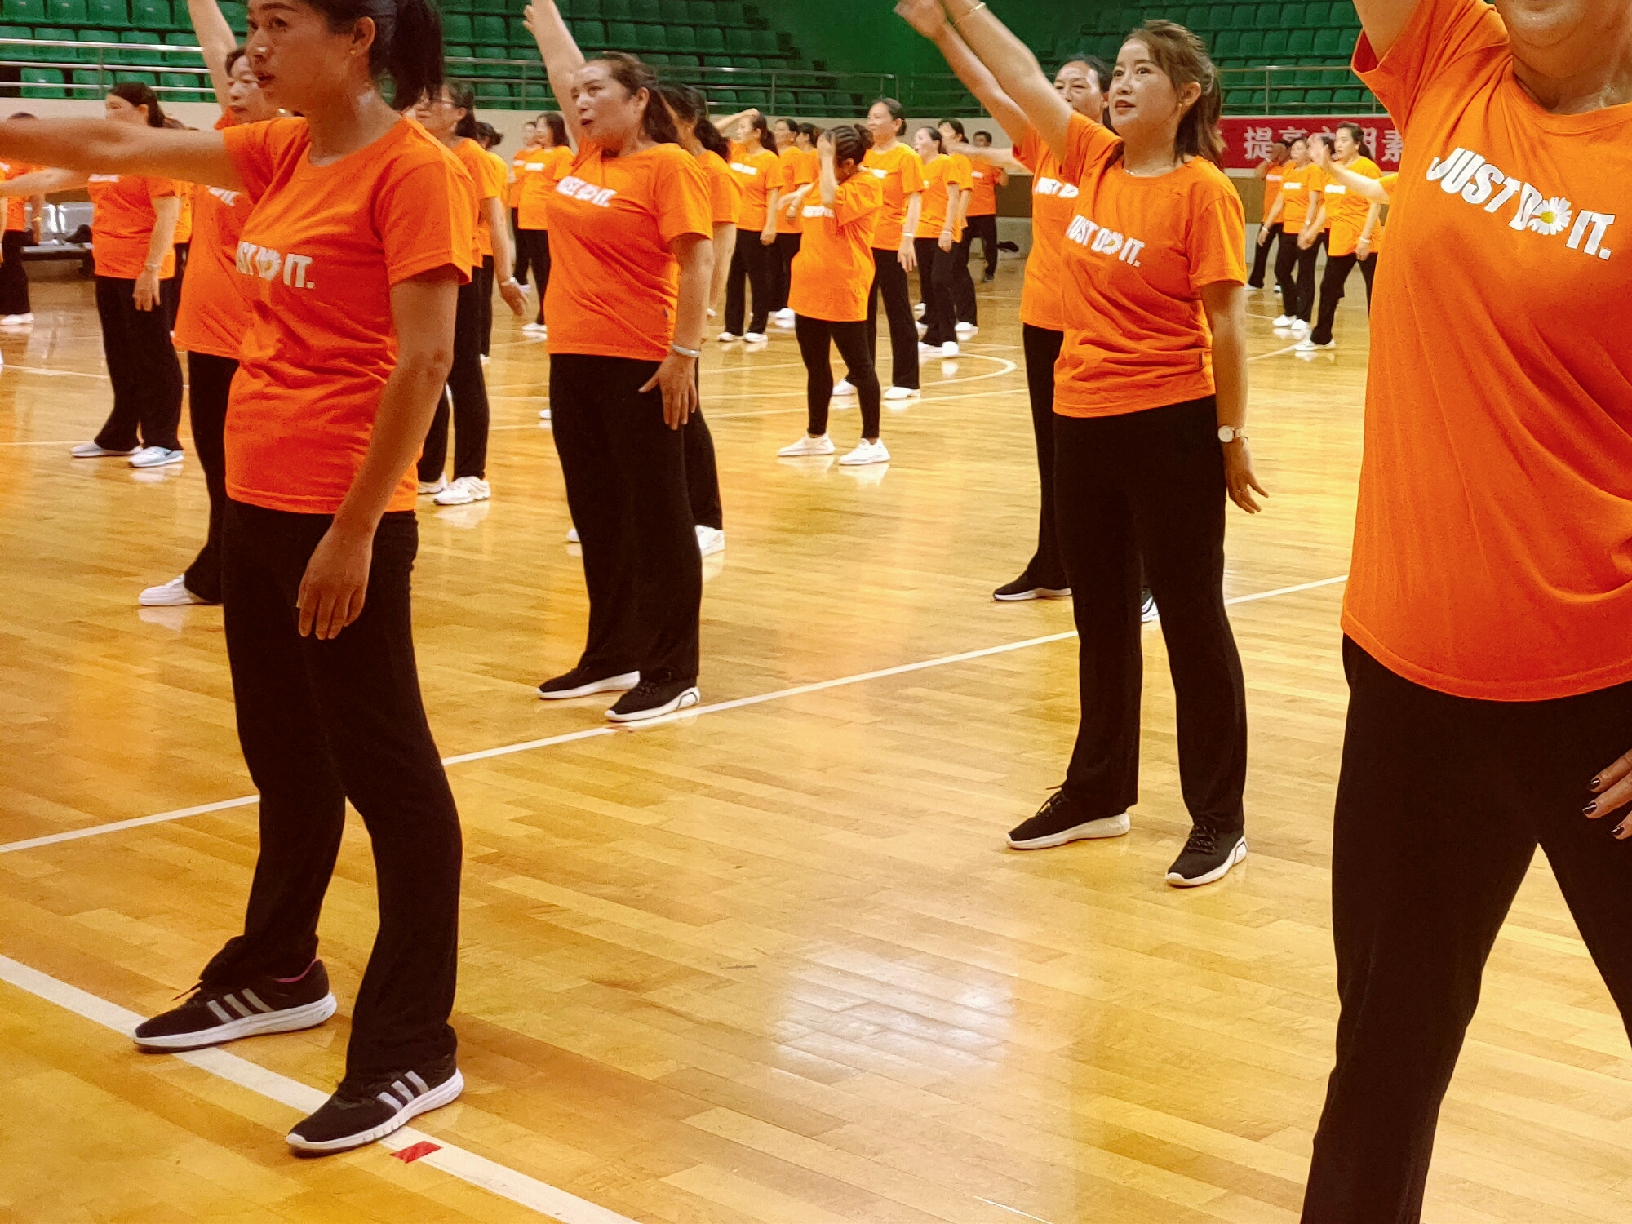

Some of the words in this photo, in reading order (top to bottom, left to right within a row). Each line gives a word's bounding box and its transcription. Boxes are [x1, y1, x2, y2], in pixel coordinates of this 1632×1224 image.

[1426, 147, 1521, 213] JUST
[1565, 209, 1616, 260] IT.
[1119, 237, 1145, 267] IT.
[283, 253, 315, 289] IT.
